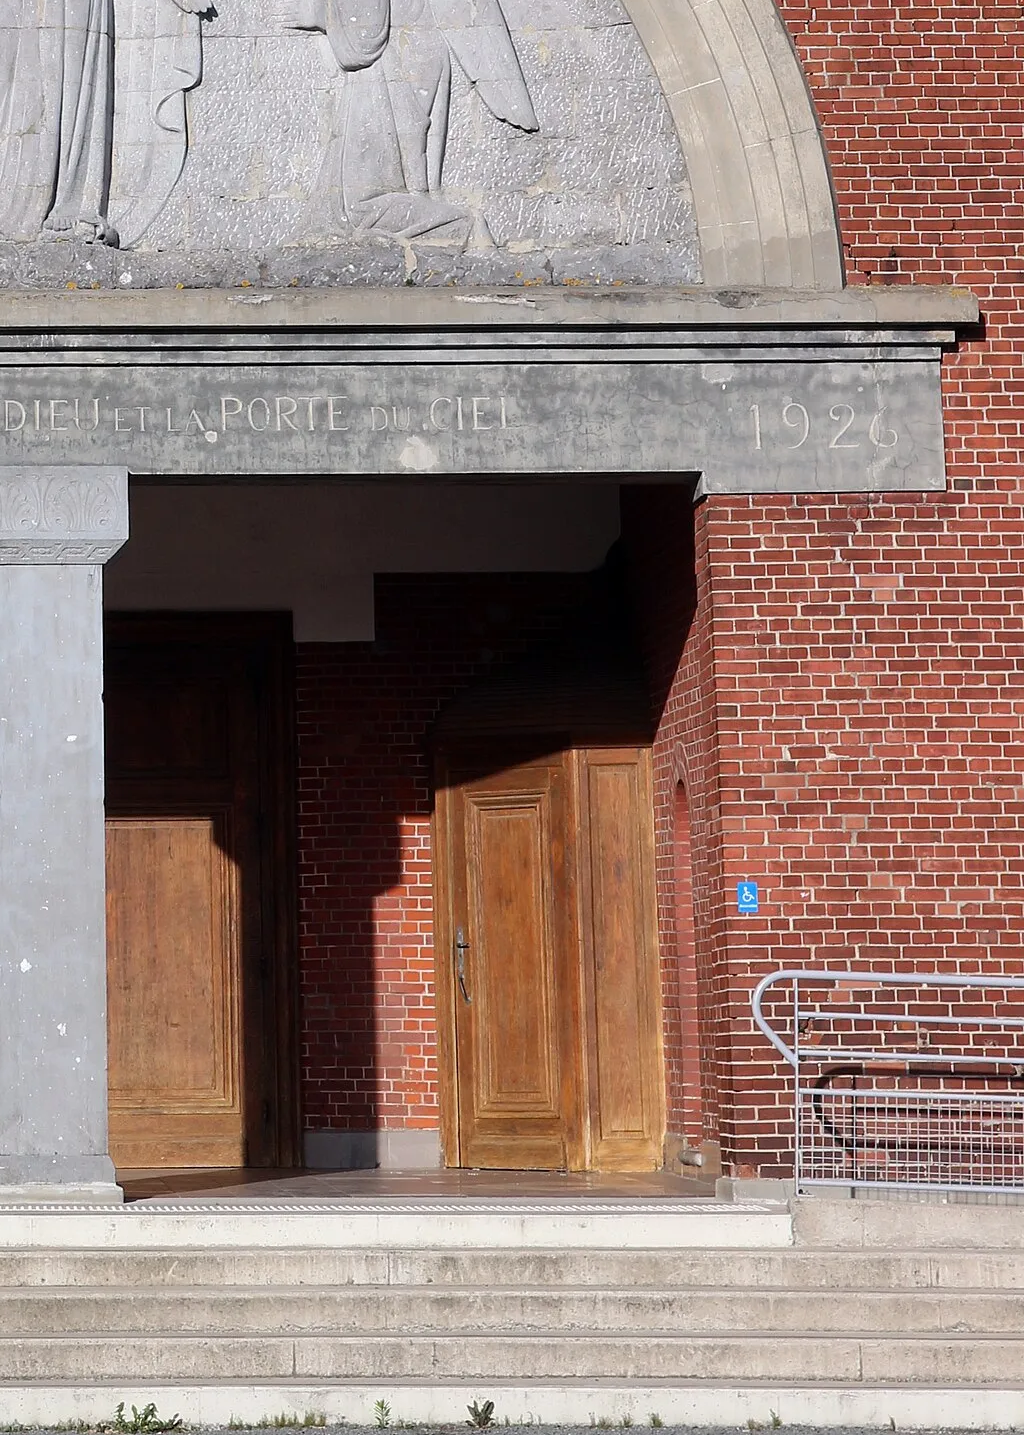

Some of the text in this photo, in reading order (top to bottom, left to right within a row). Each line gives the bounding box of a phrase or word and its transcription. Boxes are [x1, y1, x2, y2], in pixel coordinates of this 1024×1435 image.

[3, 398, 102, 432] DIEU
[114, 406, 151, 433] ET
[166, 407, 206, 433] LA
[219, 396, 349, 432] PORTE
[370, 406, 412, 432] DU
[429, 396, 519, 431] CIEL
[749, 402, 899, 450] 1926
